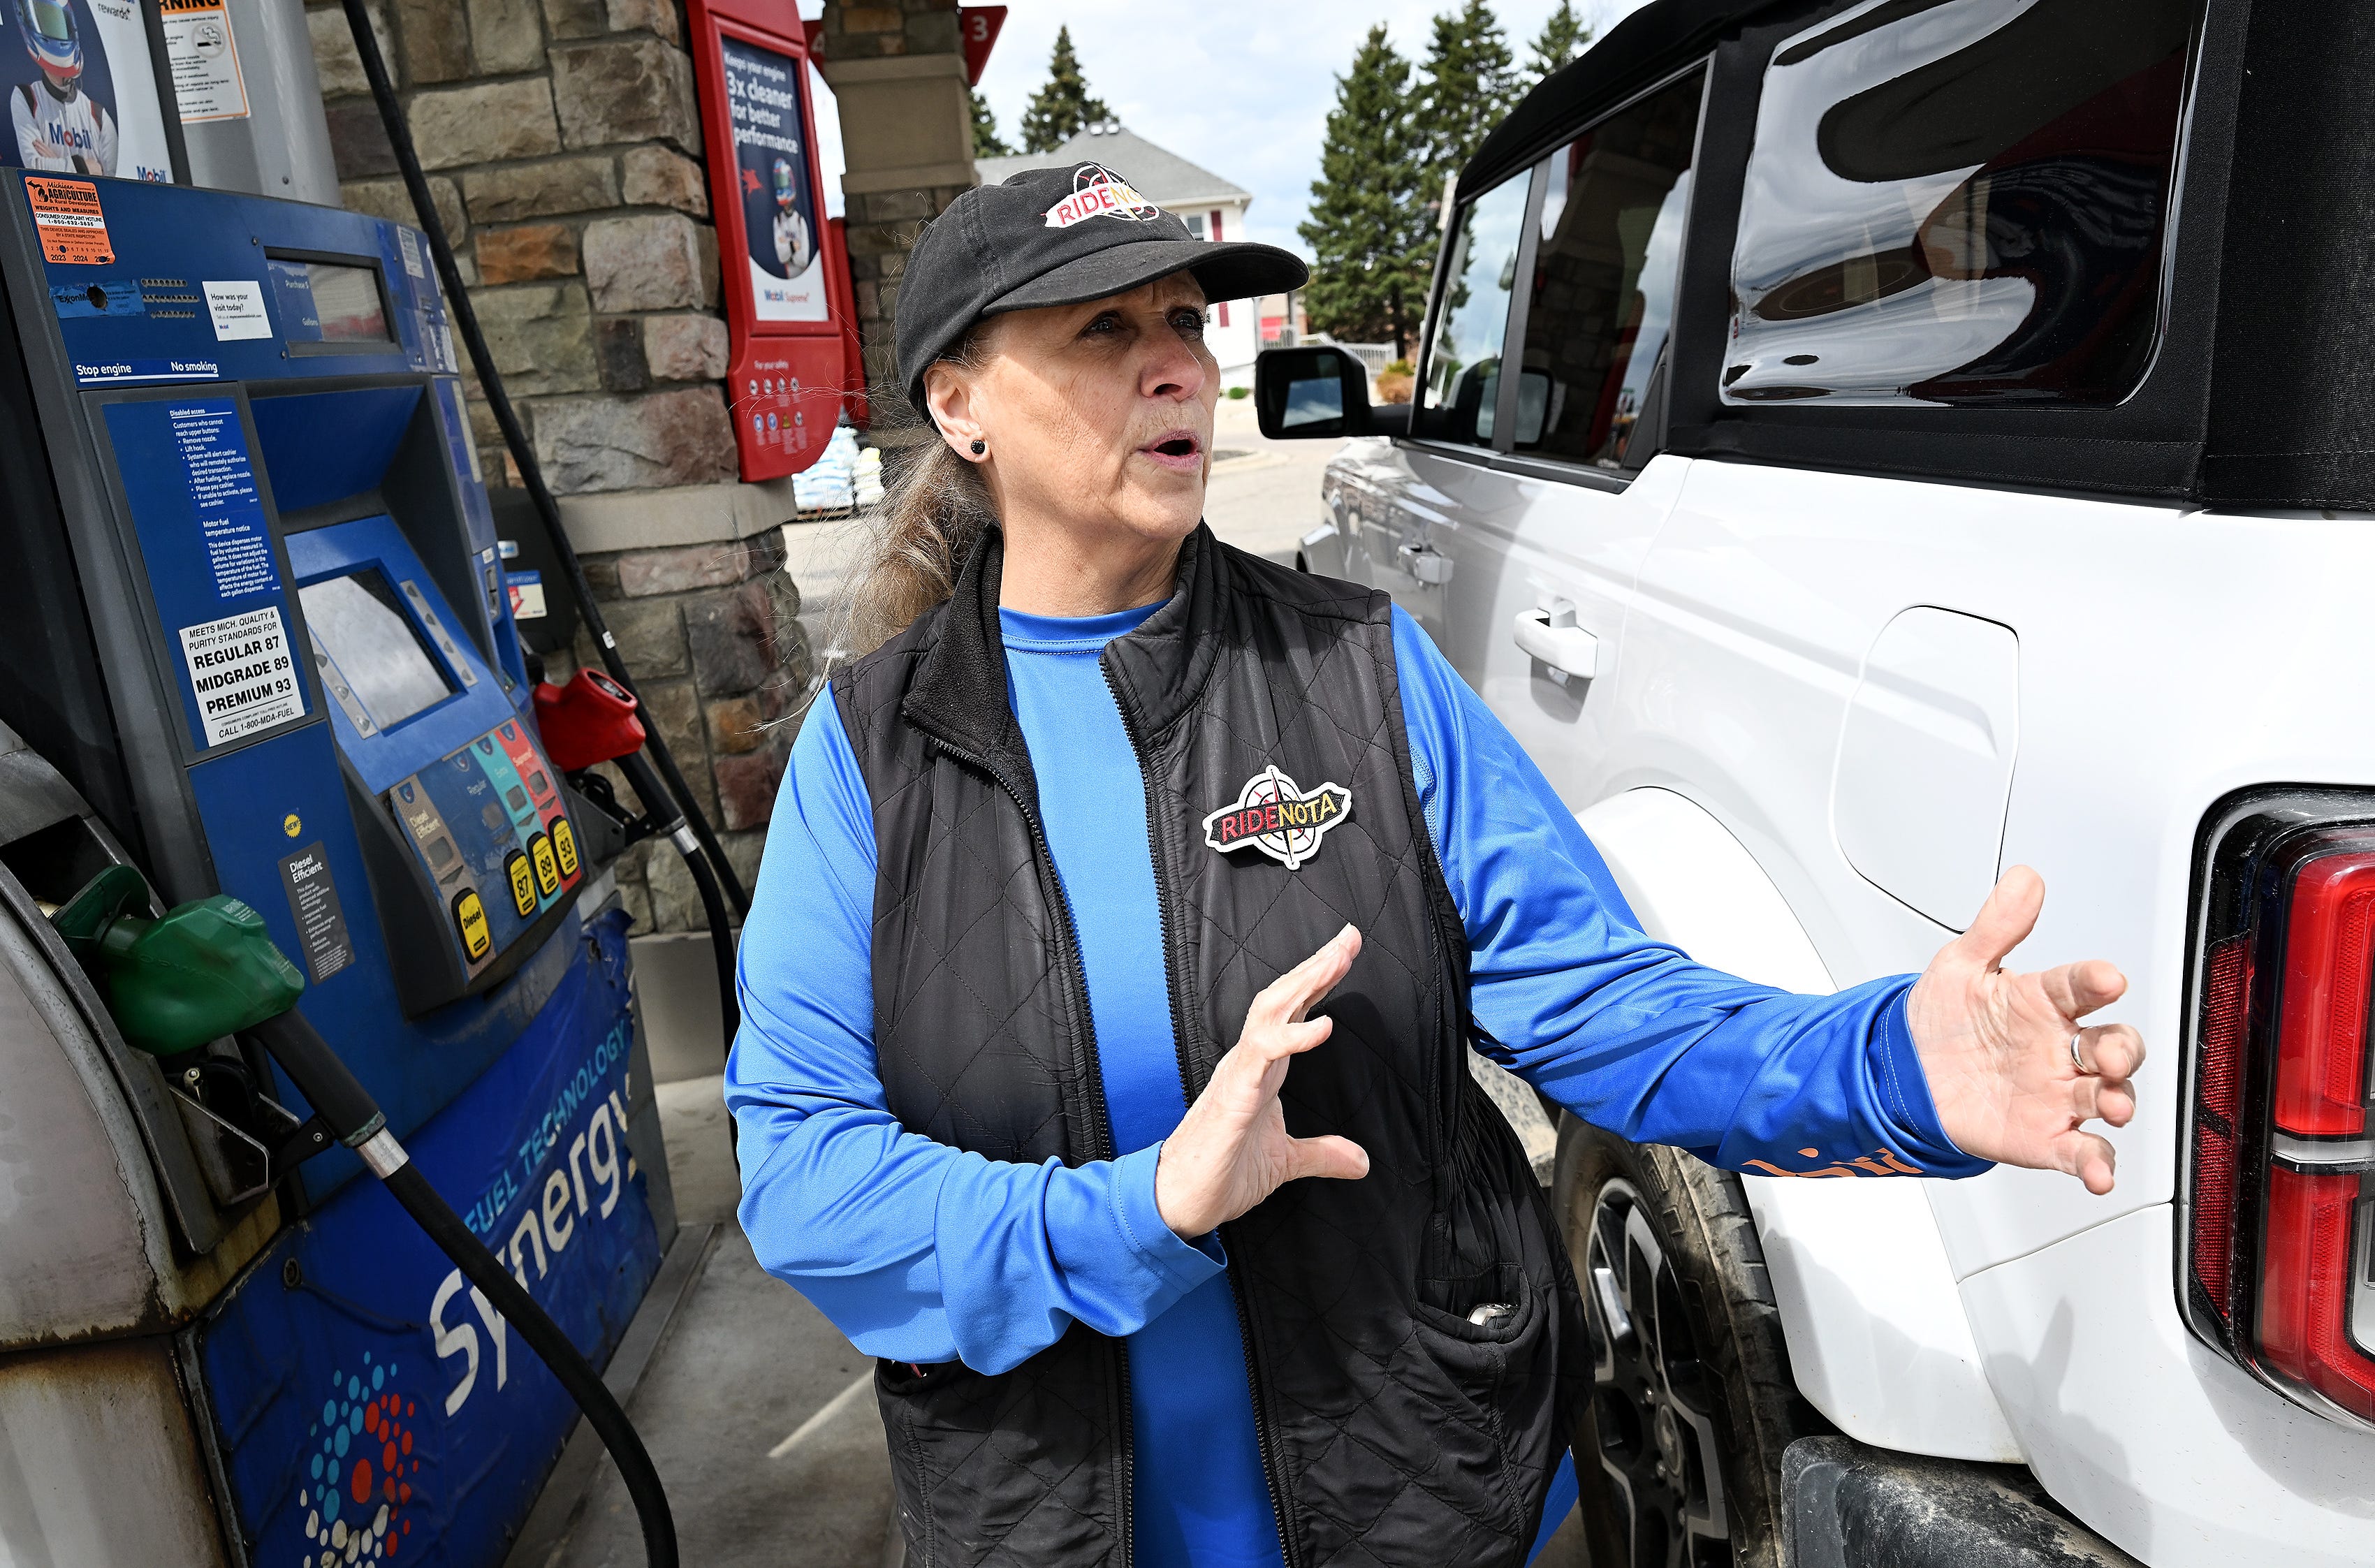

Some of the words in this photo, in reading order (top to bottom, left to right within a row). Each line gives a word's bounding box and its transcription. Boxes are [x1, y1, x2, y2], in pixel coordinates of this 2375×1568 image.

[972, 15, 988, 42] 3
[810, 31, 825, 53] 4
[724, 51, 746, 72] Keeps
[747, 61, 762, 75] your
[763, 66, 786, 82] engine
[726, 71, 747, 98] 3x
[747, 76, 792, 110] cleaner
[730, 97, 747, 120] for
[747, 101, 780, 129] better
[49, 122, 92, 149] Mobil
[734, 124, 798, 154] performance
[137, 166, 166, 182] Mobil
[48, 189, 97, 202] AGRICULTURE
[1057, 186, 1143, 225] RIDENO
[764, 289, 784, 301] Mobil
[226, 304, 243, 312] today?
[76, 365, 98, 377] Stop
[101, 363, 131, 376] engine
[170, 362, 183, 372] No
[185, 361, 218, 373] smoking
[205, 527, 235, 536] temperature
[189, 624, 216, 638] MEETS
[217, 621, 238, 631] MICH.
[239, 613, 269, 626] QUALITY
[189, 638, 217, 650] PURITY
[218, 627, 262, 643] STANDARDS
[263, 622, 277, 632] FOR
[193, 640, 263, 670] REGULAR
[265, 636, 279, 650] 87
[196, 661, 272, 693] MIDGRADE
[274, 656, 289, 671] 89
[206, 683, 273, 714] PREMIUM
[275, 678, 291, 692] 93
[219, 727, 239, 738] CALL
[240, 708, 294, 732] 1-800-MDA-FUEL
[467, 779, 487, 796] Regular
[286, 820, 300, 831] NEW!
[409, 809, 430, 827] Diesel
[1221, 792, 1338, 842] RIDENOTA
[560, 837, 572, 858] 93
[289, 853, 313, 873] Diesel
[293, 861, 323, 884] Efficient
[540, 856, 552, 877] 89
[517, 875, 529, 899] 87
[463, 907, 482, 930] Diesel
[464, 1168, 519, 1234] FUEL
[519, 1018, 626, 1177] TECHNOLOGY
